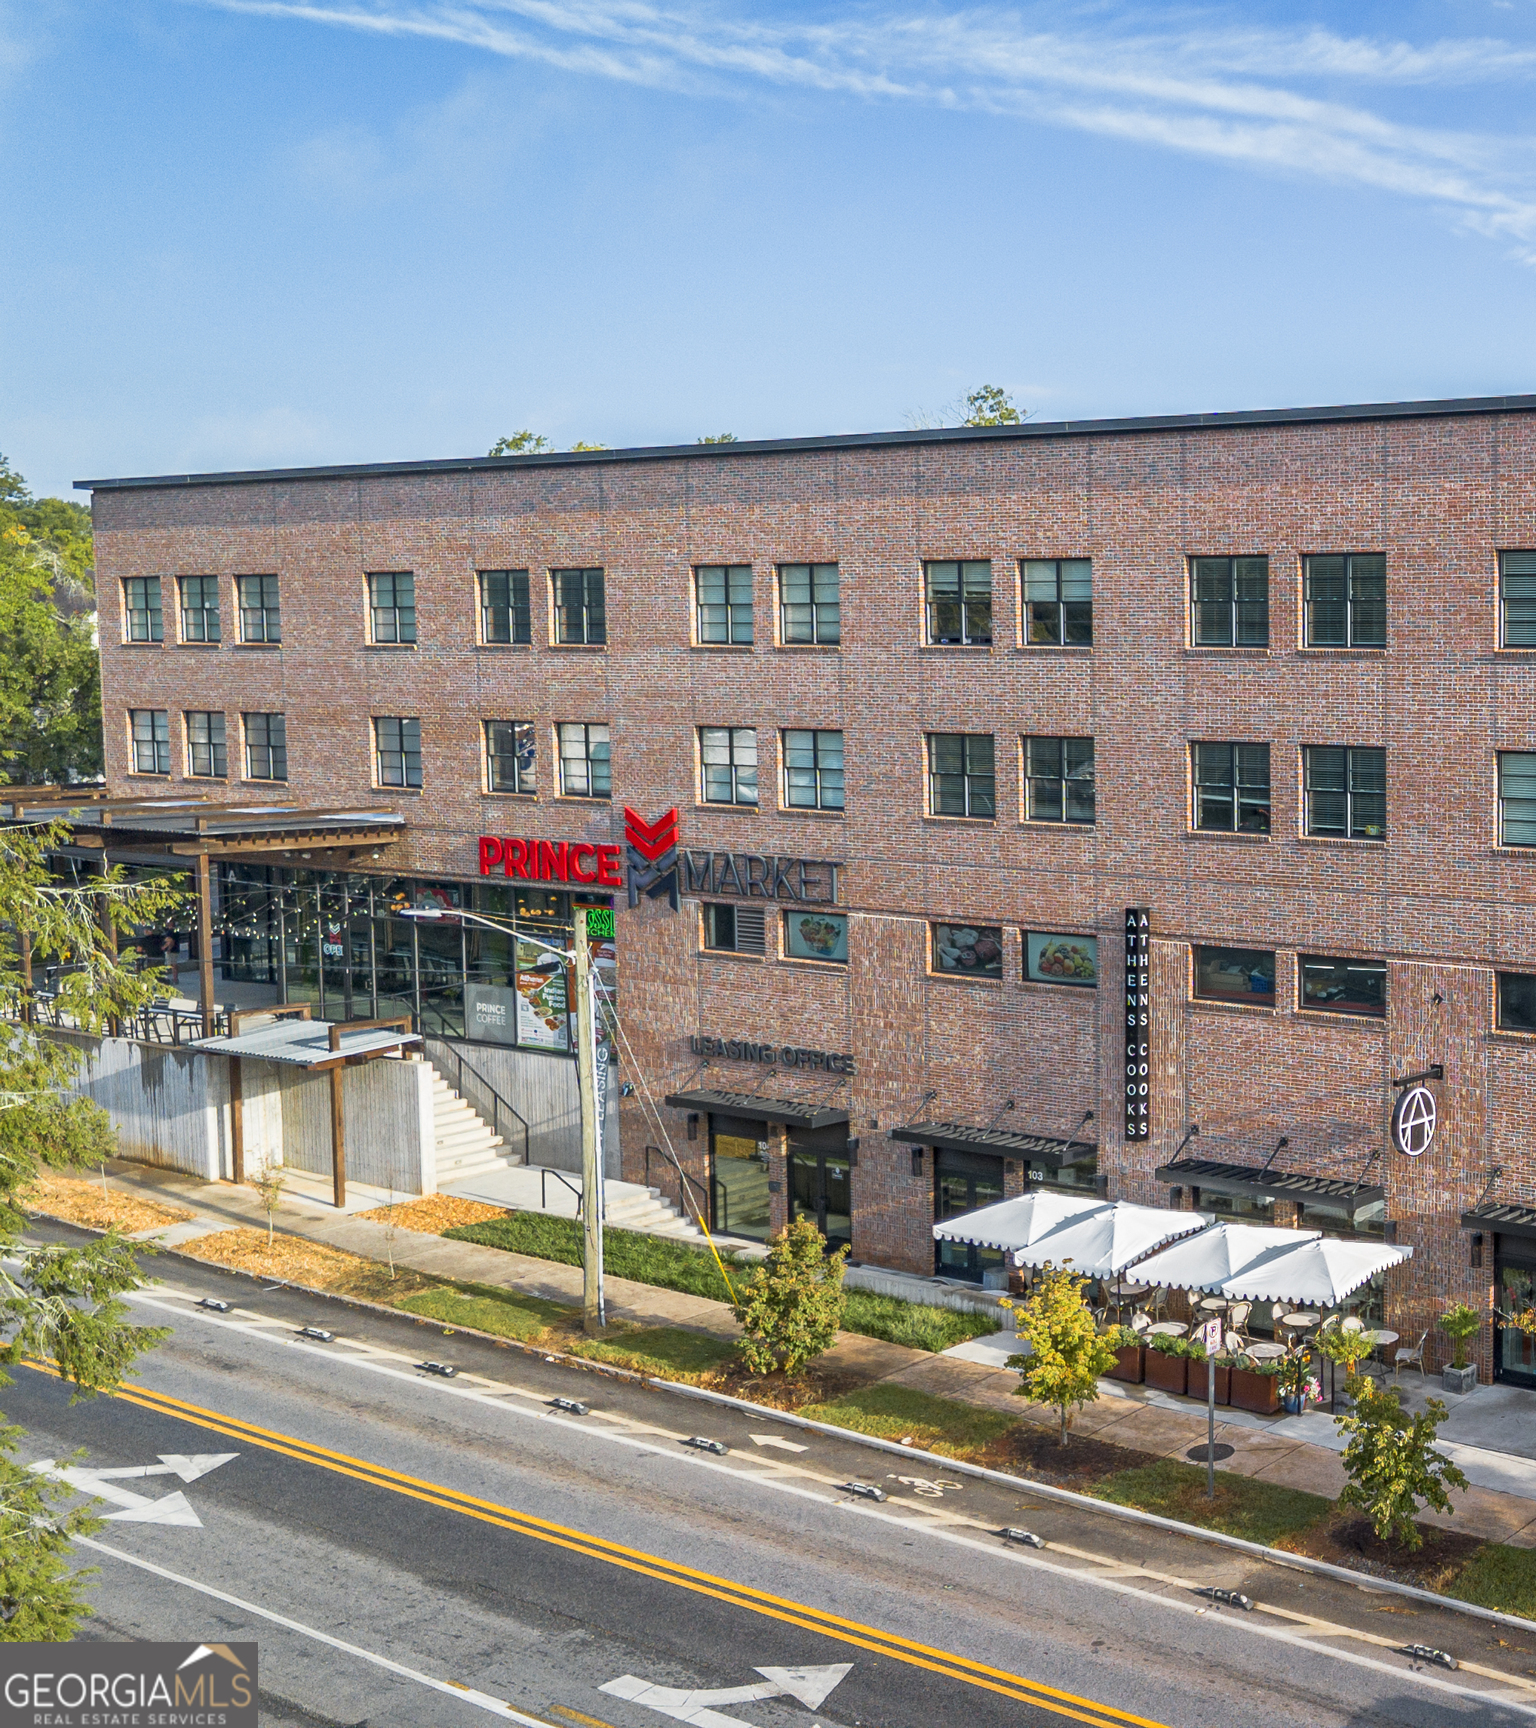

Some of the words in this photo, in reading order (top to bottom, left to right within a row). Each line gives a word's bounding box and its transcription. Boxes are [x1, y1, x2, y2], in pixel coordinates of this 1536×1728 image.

[479, 836, 622, 886] PRINCE
[684, 850, 844, 903] MARKET
[1127, 915, 1136, 1026] ATHENS
[1139, 914, 1148, 1026] ATHENS
[476, 1002, 506, 1015] PRINCE
[543, 986, 566, 995] Indian
[548, 1000, 566, 1009] Food
[476, 1014, 506, 1026] COFFEE
[690, 1035, 777, 1064] LEASING
[781, 1046, 858, 1075] OFFICE
[1127, 1044, 1136, 1135] COOKS
[1139, 1043, 1148, 1135] COOKS
[1028, 1170, 1043, 1181] 103
